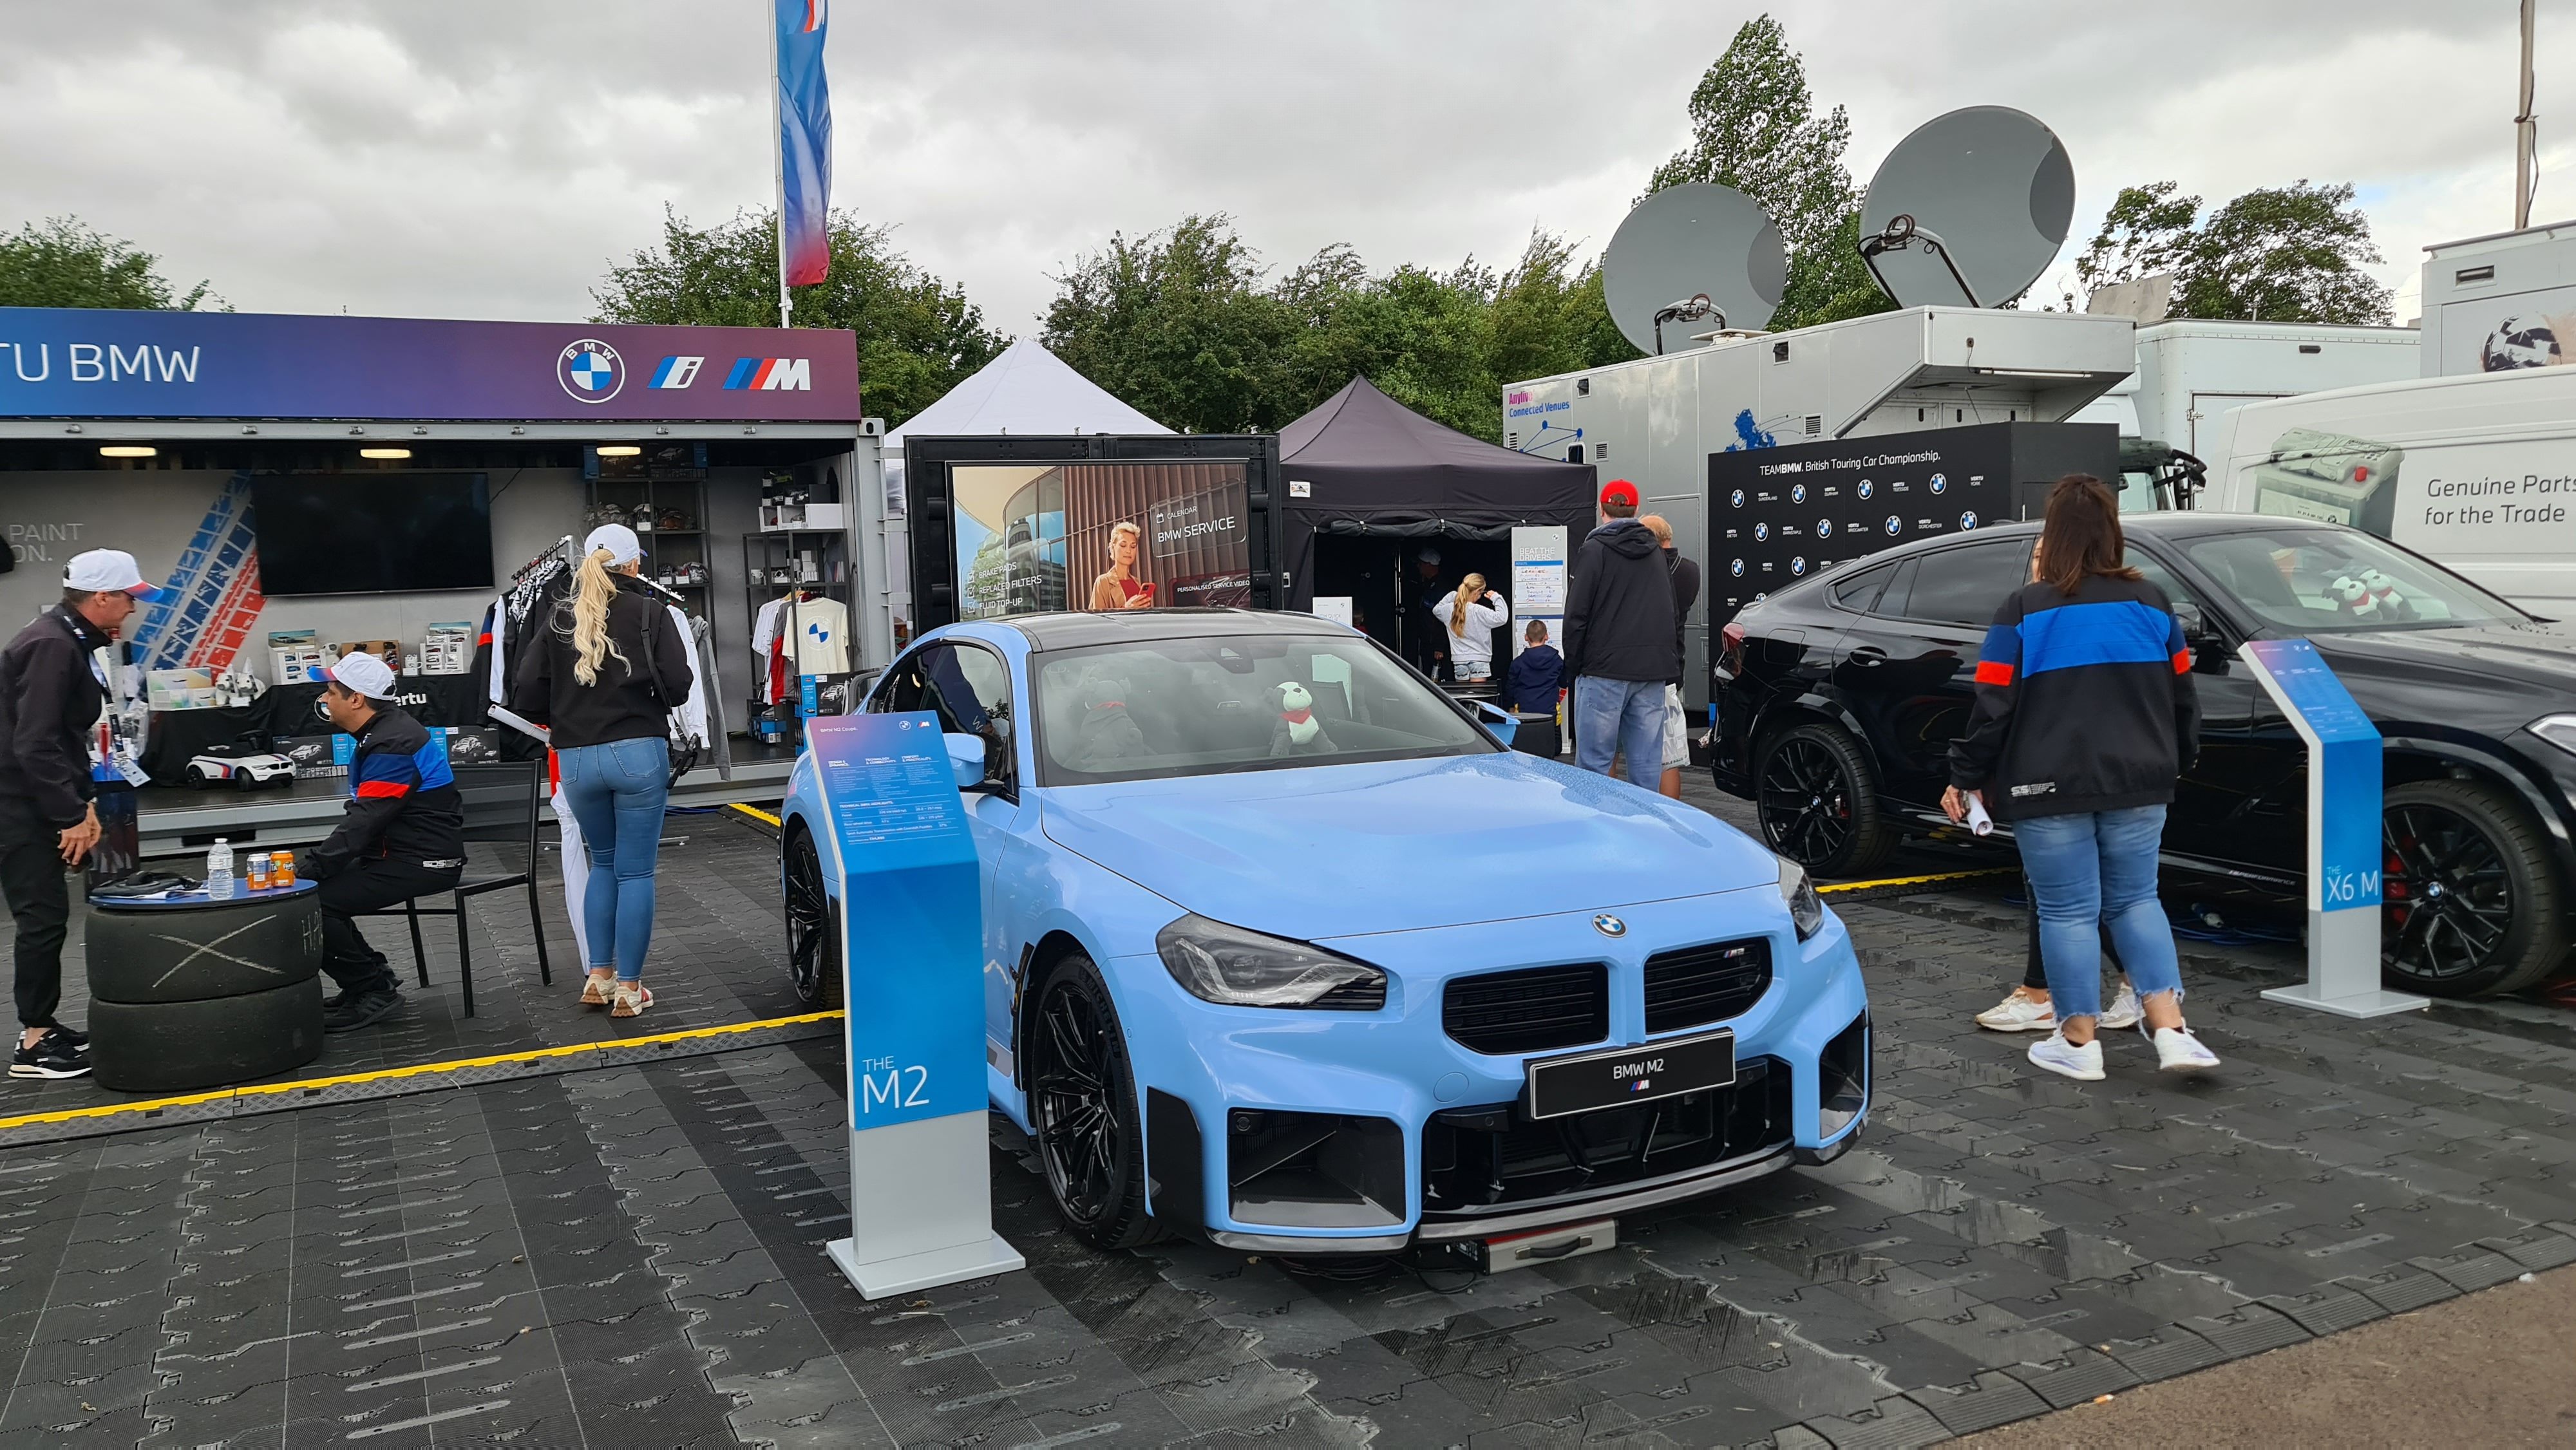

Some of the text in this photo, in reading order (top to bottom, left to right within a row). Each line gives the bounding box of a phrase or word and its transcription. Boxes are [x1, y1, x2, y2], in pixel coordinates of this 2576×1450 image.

[70, 344, 200, 382] BMW
[1510, 401, 1570, 418] Connected Venues
[1759, 450, 1941, 476] TEAMBMW. British Touring Car Championship.
[2428, 476, 2515, 498] Genuine
[1167, 506, 1197, 520] CALENDAR
[2425, 503, 2566, 525] for the Trade
[10, 523, 84, 541] PAINT
[1158, 516, 1235, 543] BMW SERVICE
[979, 562, 1017, 579] BRAKE PADS
[979, 575, 1042, 594] REPLACED FILTERS
[1177, 584, 1212, 592] PERSONALISED
[979, 598, 1023, 610] FLUID TOP-UP
[393, 692, 426, 707] ertu
[2326, 865, 2342, 875] THE
[2327, 870, 2378, 903] X6 M
[862, 1055, 895, 1072] THE
[1613, 1058, 1664, 1080] BMW M2
[863, 1065, 929, 1114] M2
